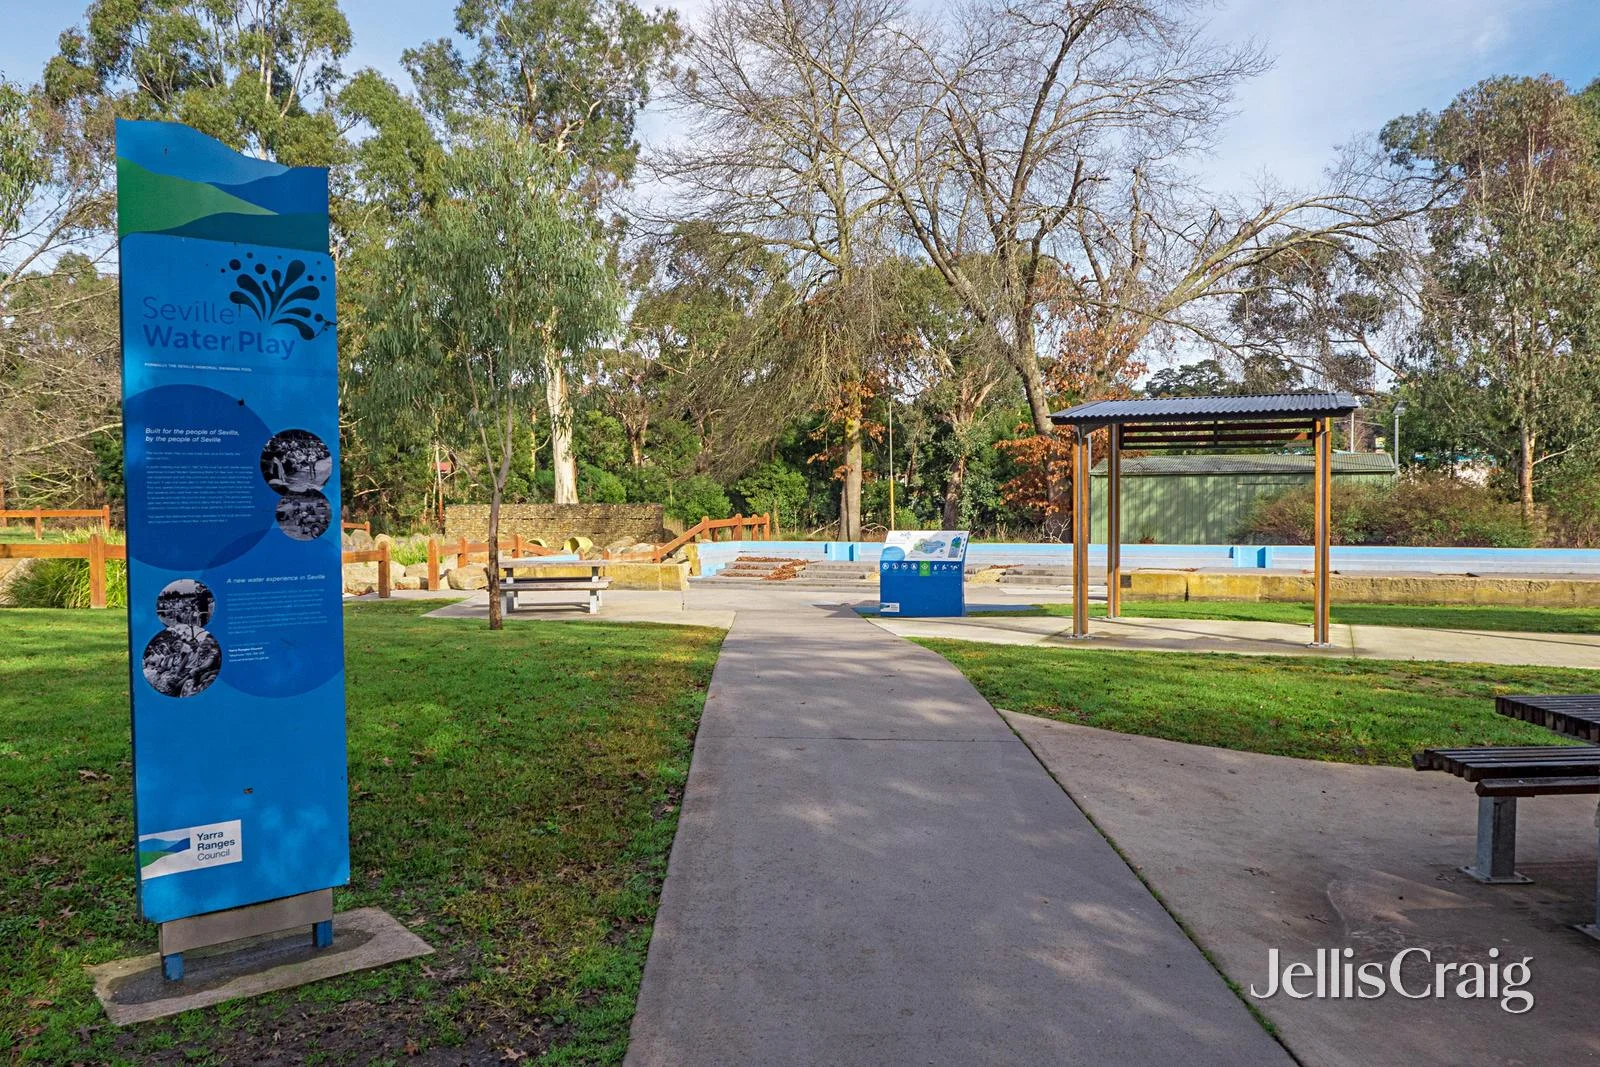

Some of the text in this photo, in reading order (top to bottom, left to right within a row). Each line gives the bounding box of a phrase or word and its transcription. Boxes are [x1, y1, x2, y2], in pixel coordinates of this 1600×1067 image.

[143, 296, 235, 325] Seville
[143, 324, 296, 360] Water Play
[197, 831, 224, 841] Yarra
[197, 839, 235, 851] Ranges
[197, 849, 230, 861] Council
